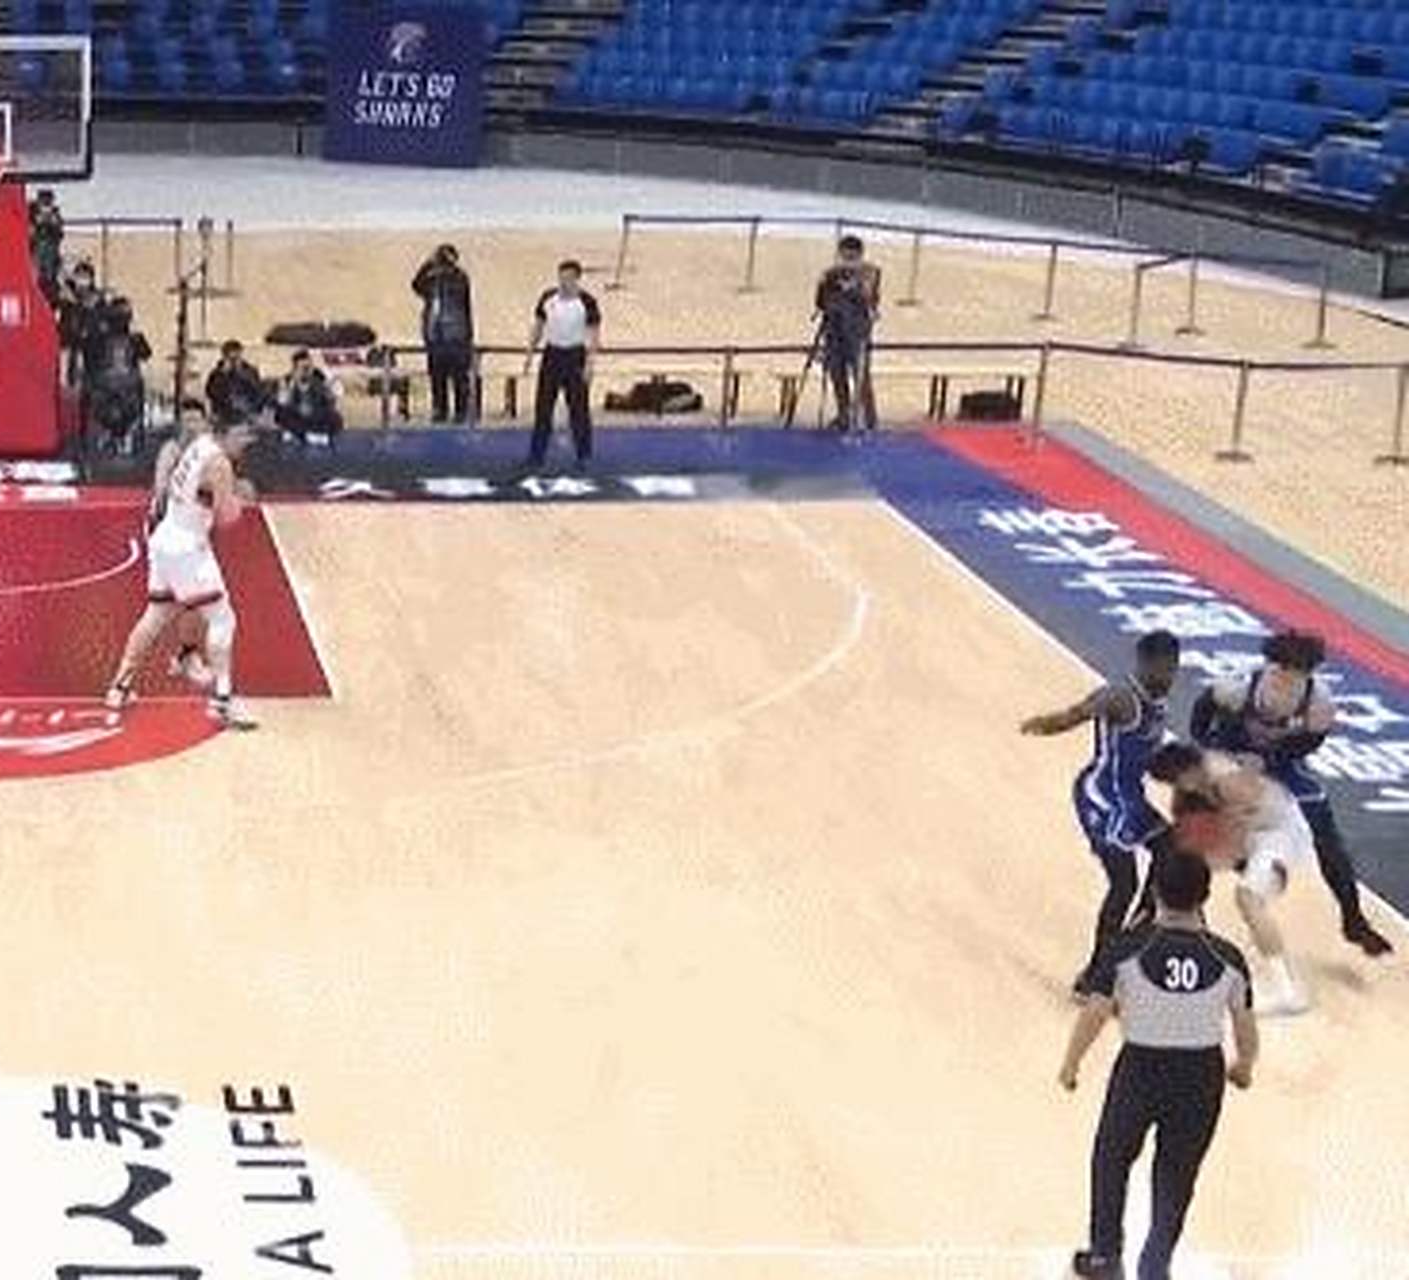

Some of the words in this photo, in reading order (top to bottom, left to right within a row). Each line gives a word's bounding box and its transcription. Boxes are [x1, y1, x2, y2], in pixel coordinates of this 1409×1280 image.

[1165, 957, 1199, 989] 30
[41, 1078, 203, 1280] 人寿
[221, 1084, 317, 1204] LIFE
